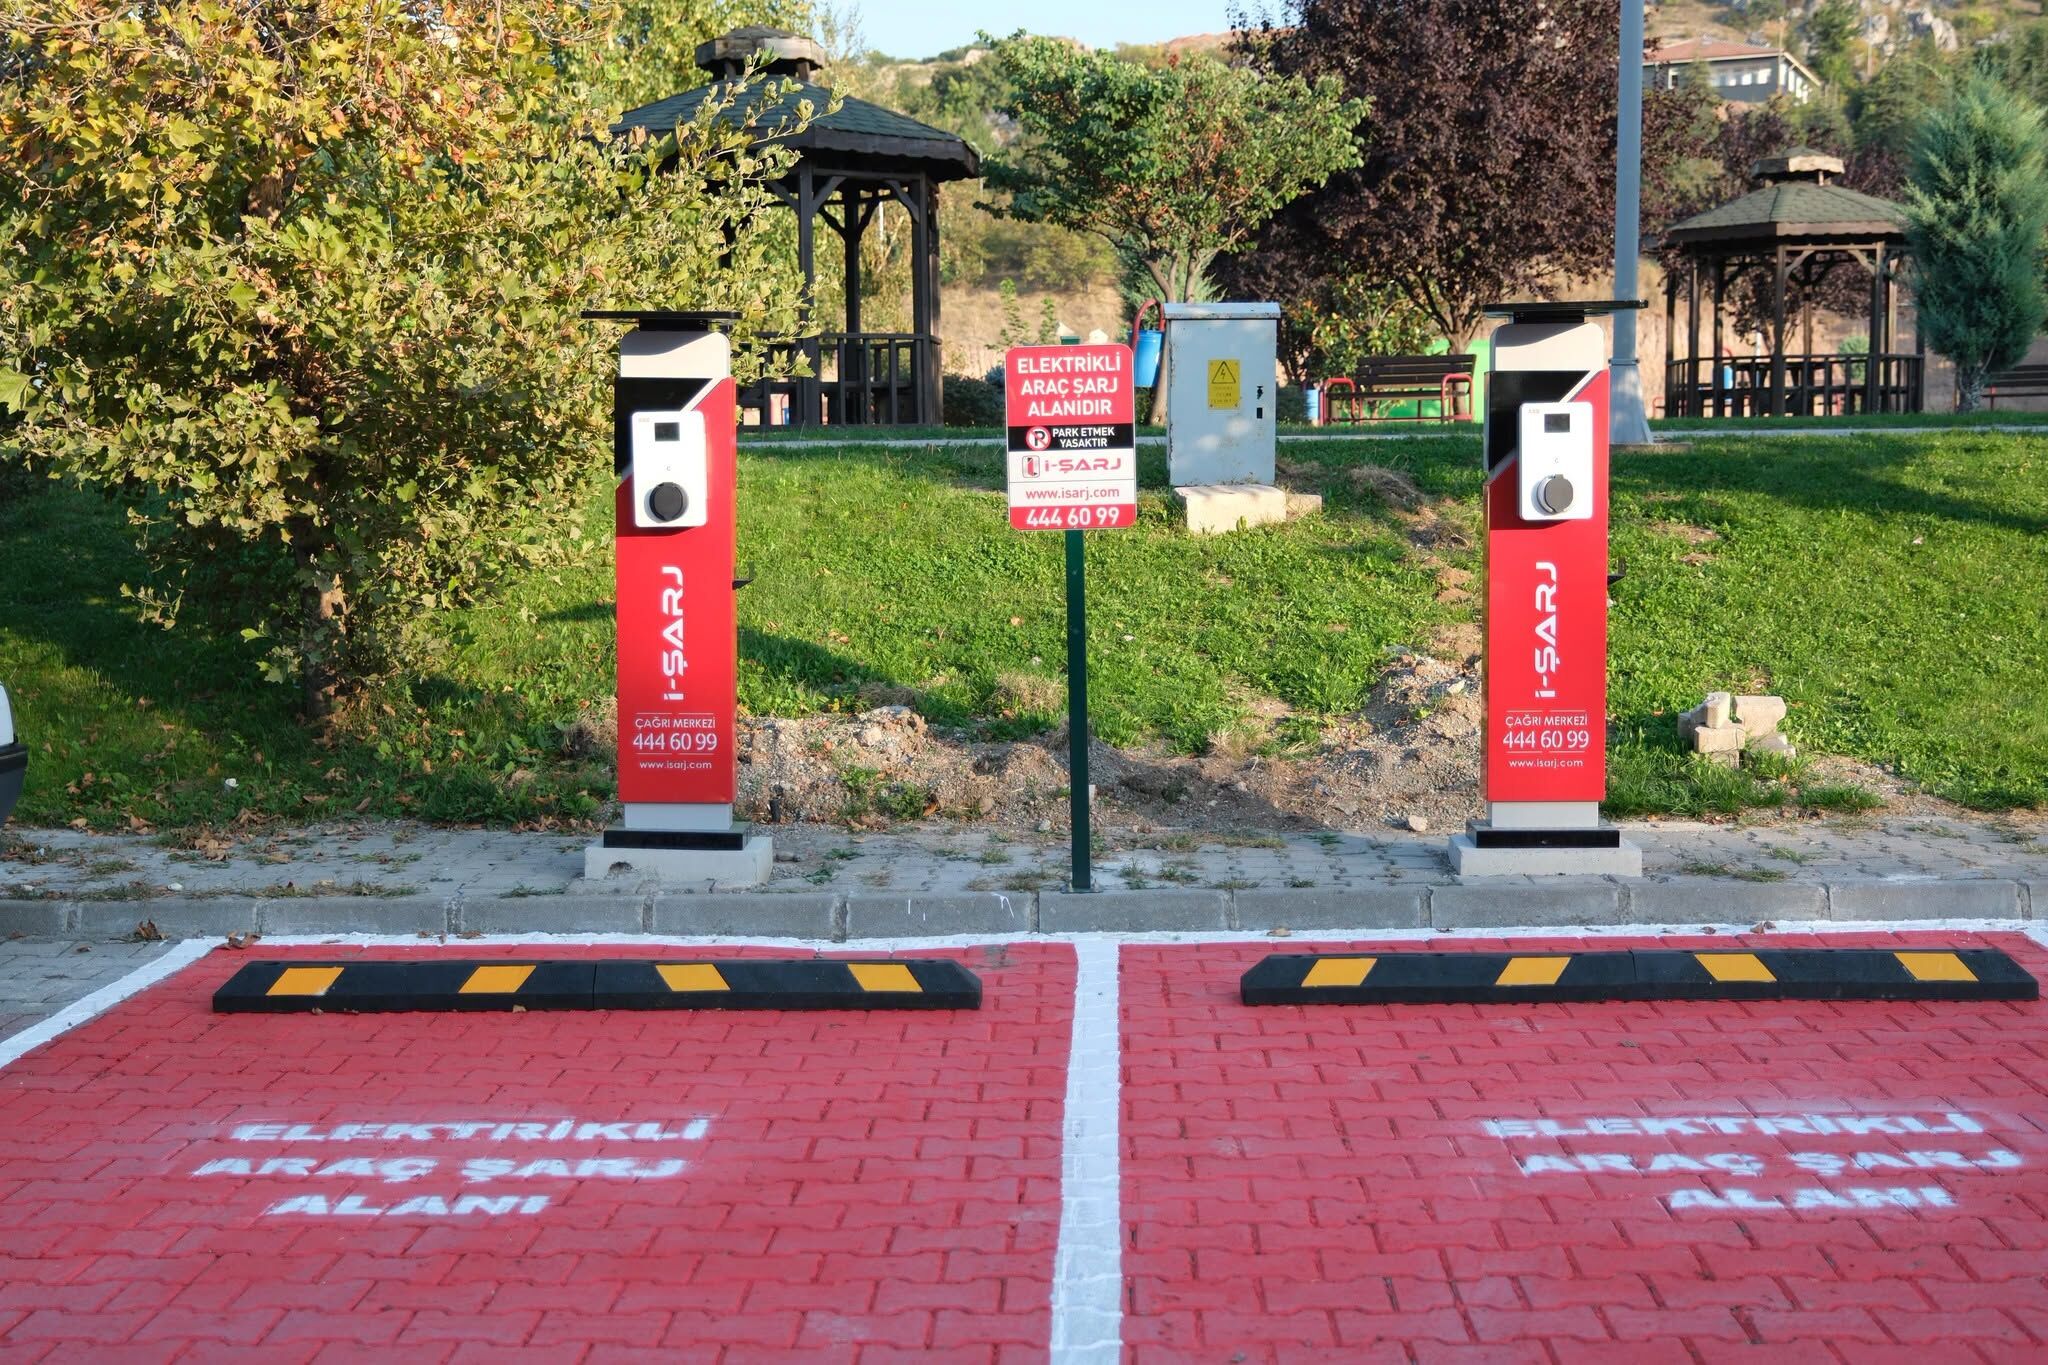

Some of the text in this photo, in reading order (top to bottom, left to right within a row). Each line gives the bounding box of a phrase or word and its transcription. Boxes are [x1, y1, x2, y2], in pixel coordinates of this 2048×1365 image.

[1017, 351, 1121, 374] ELEKTRİKLİ
[1020, 377, 1118, 398] ARAÇ ŞARJ
[1027, 399, 1112, 417] ALANIDIR
[1052, 426, 1115, 438] PARK ETMEK
[1060, 438, 1108, 448] YASAKTIR
[1026, 487, 1120, 500] www.isarj.com
[1026, 507, 1120, 526] 444 60 99
[635, 716, 716, 730] ÇAĞRI MERKEZİ
[1505, 713, 1588, 728] ÇAĞRI MERKEZİ
[633, 733, 718, 750] 444 60 99
[1503, 730, 1589, 748] 444 60 99
[639, 760, 712, 770] www.isarj.com
[1509, 759, 1583, 768] www.isarj.com
[192, 1157, 687, 1183] ARAÇ ŞARJ
[1524, 1150, 2023, 1177] ARAÇ ŞARJ
[266, 1195, 551, 1215] ALANI
[1670, 1187, 1955, 1209] ALANI
